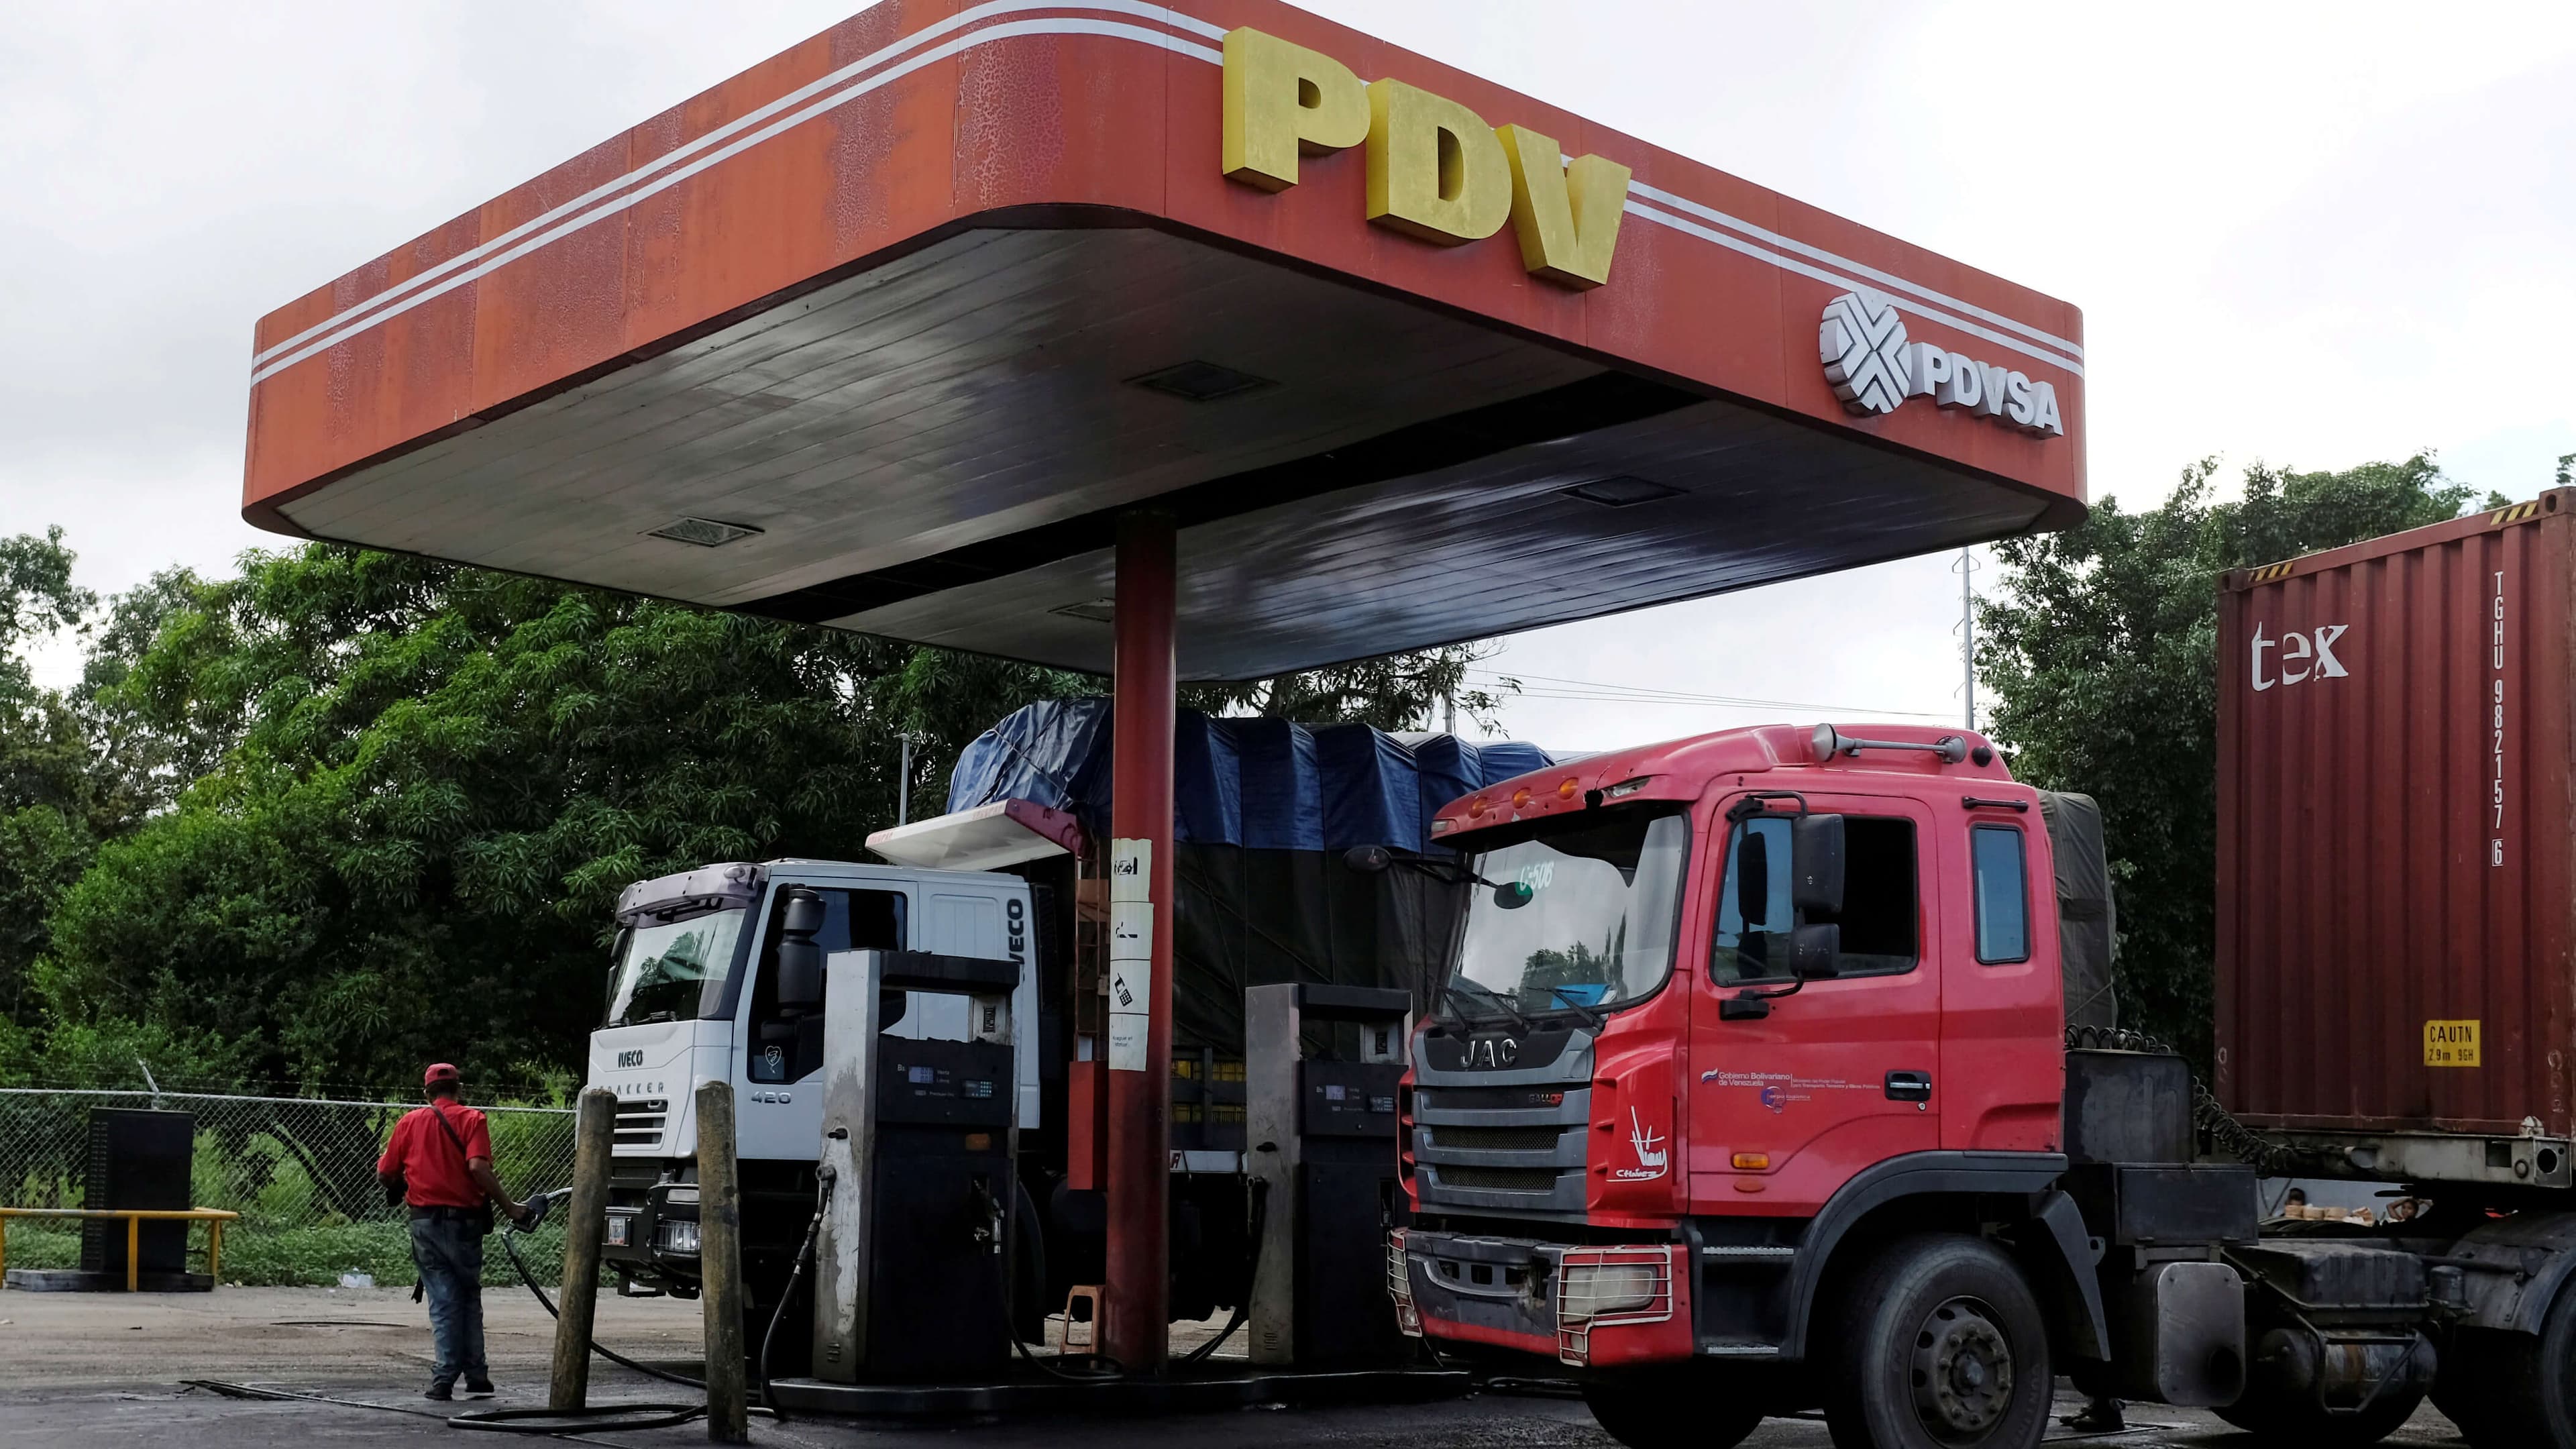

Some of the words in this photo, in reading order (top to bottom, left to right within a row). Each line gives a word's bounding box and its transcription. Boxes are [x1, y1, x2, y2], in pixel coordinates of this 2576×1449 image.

[1222, 26, 1632, 291] PDV
[1911, 342, 2063, 439] PDVSA
[2494, 572, 2504, 669] TGHU
[2251, 621, 2349, 691] tex
[2494, 680, 2504, 828] 982157
[2493, 840, 2503, 865] 6
[2430, 1026, 2472, 1042] CAUTN
[618, 1049, 643, 1068] IVECO
[1460, 1038, 1517, 1068] JAC
[1729, 1079, 1764, 1087] Venezuela
[1751, 1072, 1790, 1081] Bolivariano
[751, 1091, 791, 1104] 420
